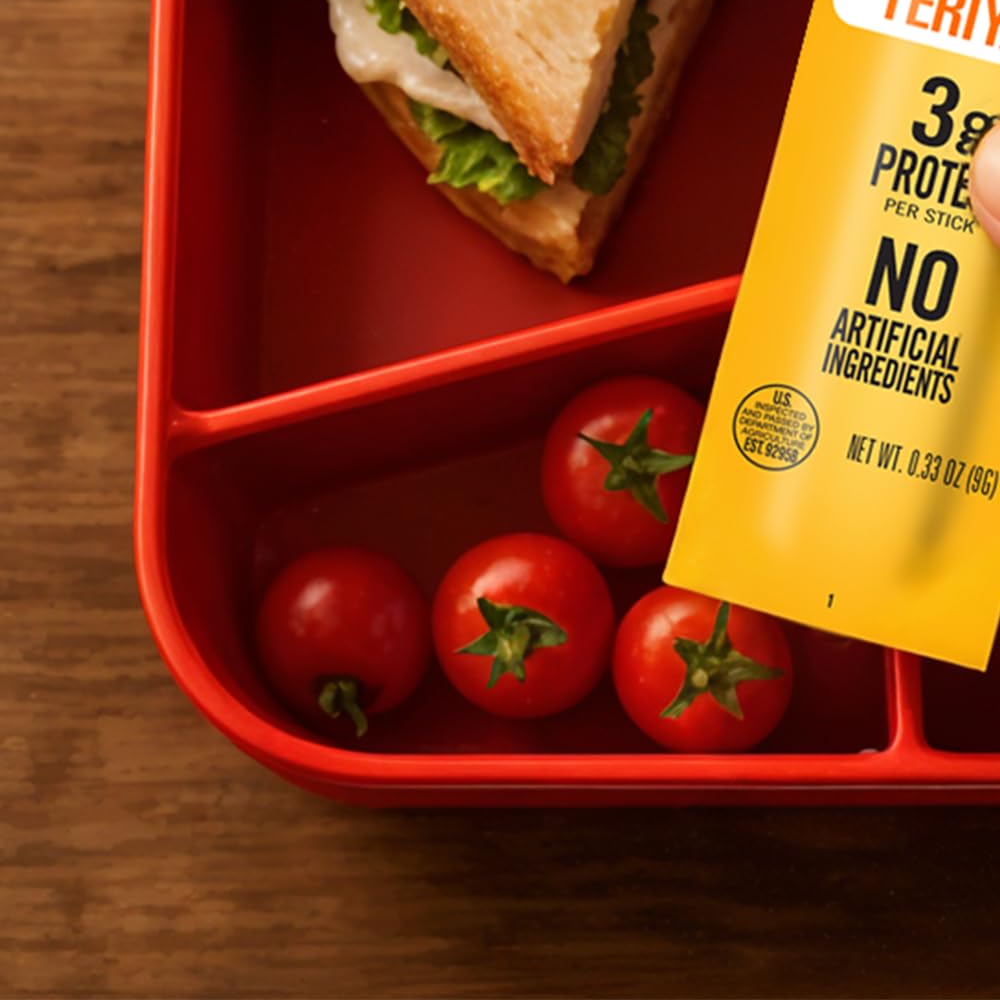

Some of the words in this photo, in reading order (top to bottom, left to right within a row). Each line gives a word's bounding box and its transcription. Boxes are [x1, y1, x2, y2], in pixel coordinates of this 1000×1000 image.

[870, 143, 972, 210] PROTE
[884, 198, 919, 220] PER
[924, 208, 975, 234] STICK
[864, 236, 960, 321] NO
[830, 307, 960, 372] ARTIFICIAL
[821, 343, 955, 405] INGREDIENTS
[739, 416, 799, 437] DEPARTMENT
[741, 408, 762, 420] AND
[763, 413, 800, 428] PASSED
[755, 401, 806, 421] INSPECTED
[846, 433, 877, 465] NET
[877, 441, 903, 474] WT.
[907, 449, 943, 482] 0.33
[943, 458, 967, 489] OZ
[966, 464, 999, 500] (9G)
